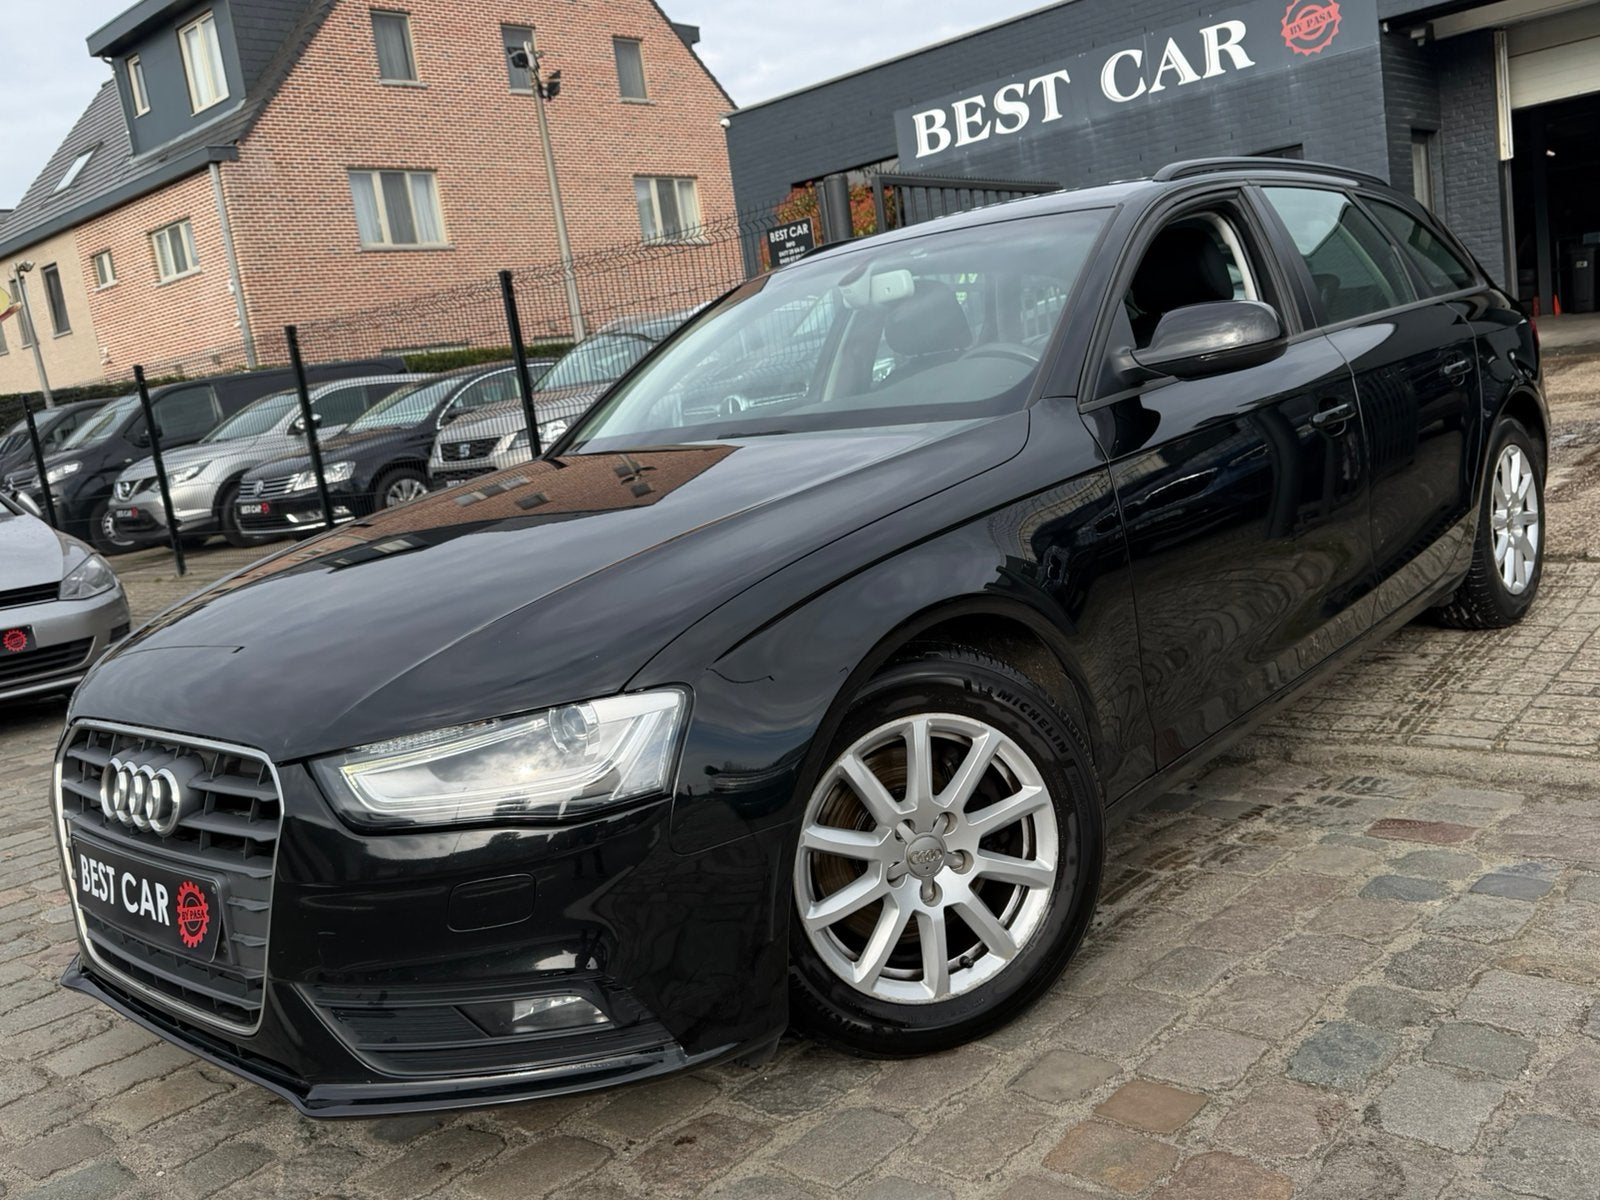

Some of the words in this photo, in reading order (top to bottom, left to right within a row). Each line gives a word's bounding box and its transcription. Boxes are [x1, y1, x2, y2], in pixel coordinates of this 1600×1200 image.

[912, 69, 1071, 159] BEST
[1100, 19, 1256, 103] CAR
[769, 228, 788, 243] BEST
[789, 223, 809, 237] CAR
[996, 689, 1070, 754] MICHELIN
[79, 853, 115, 905] BEST
[121, 871, 170, 926] CAR
[181, 909, 190, 920] BY
[189, 908, 205, 920] PASA
